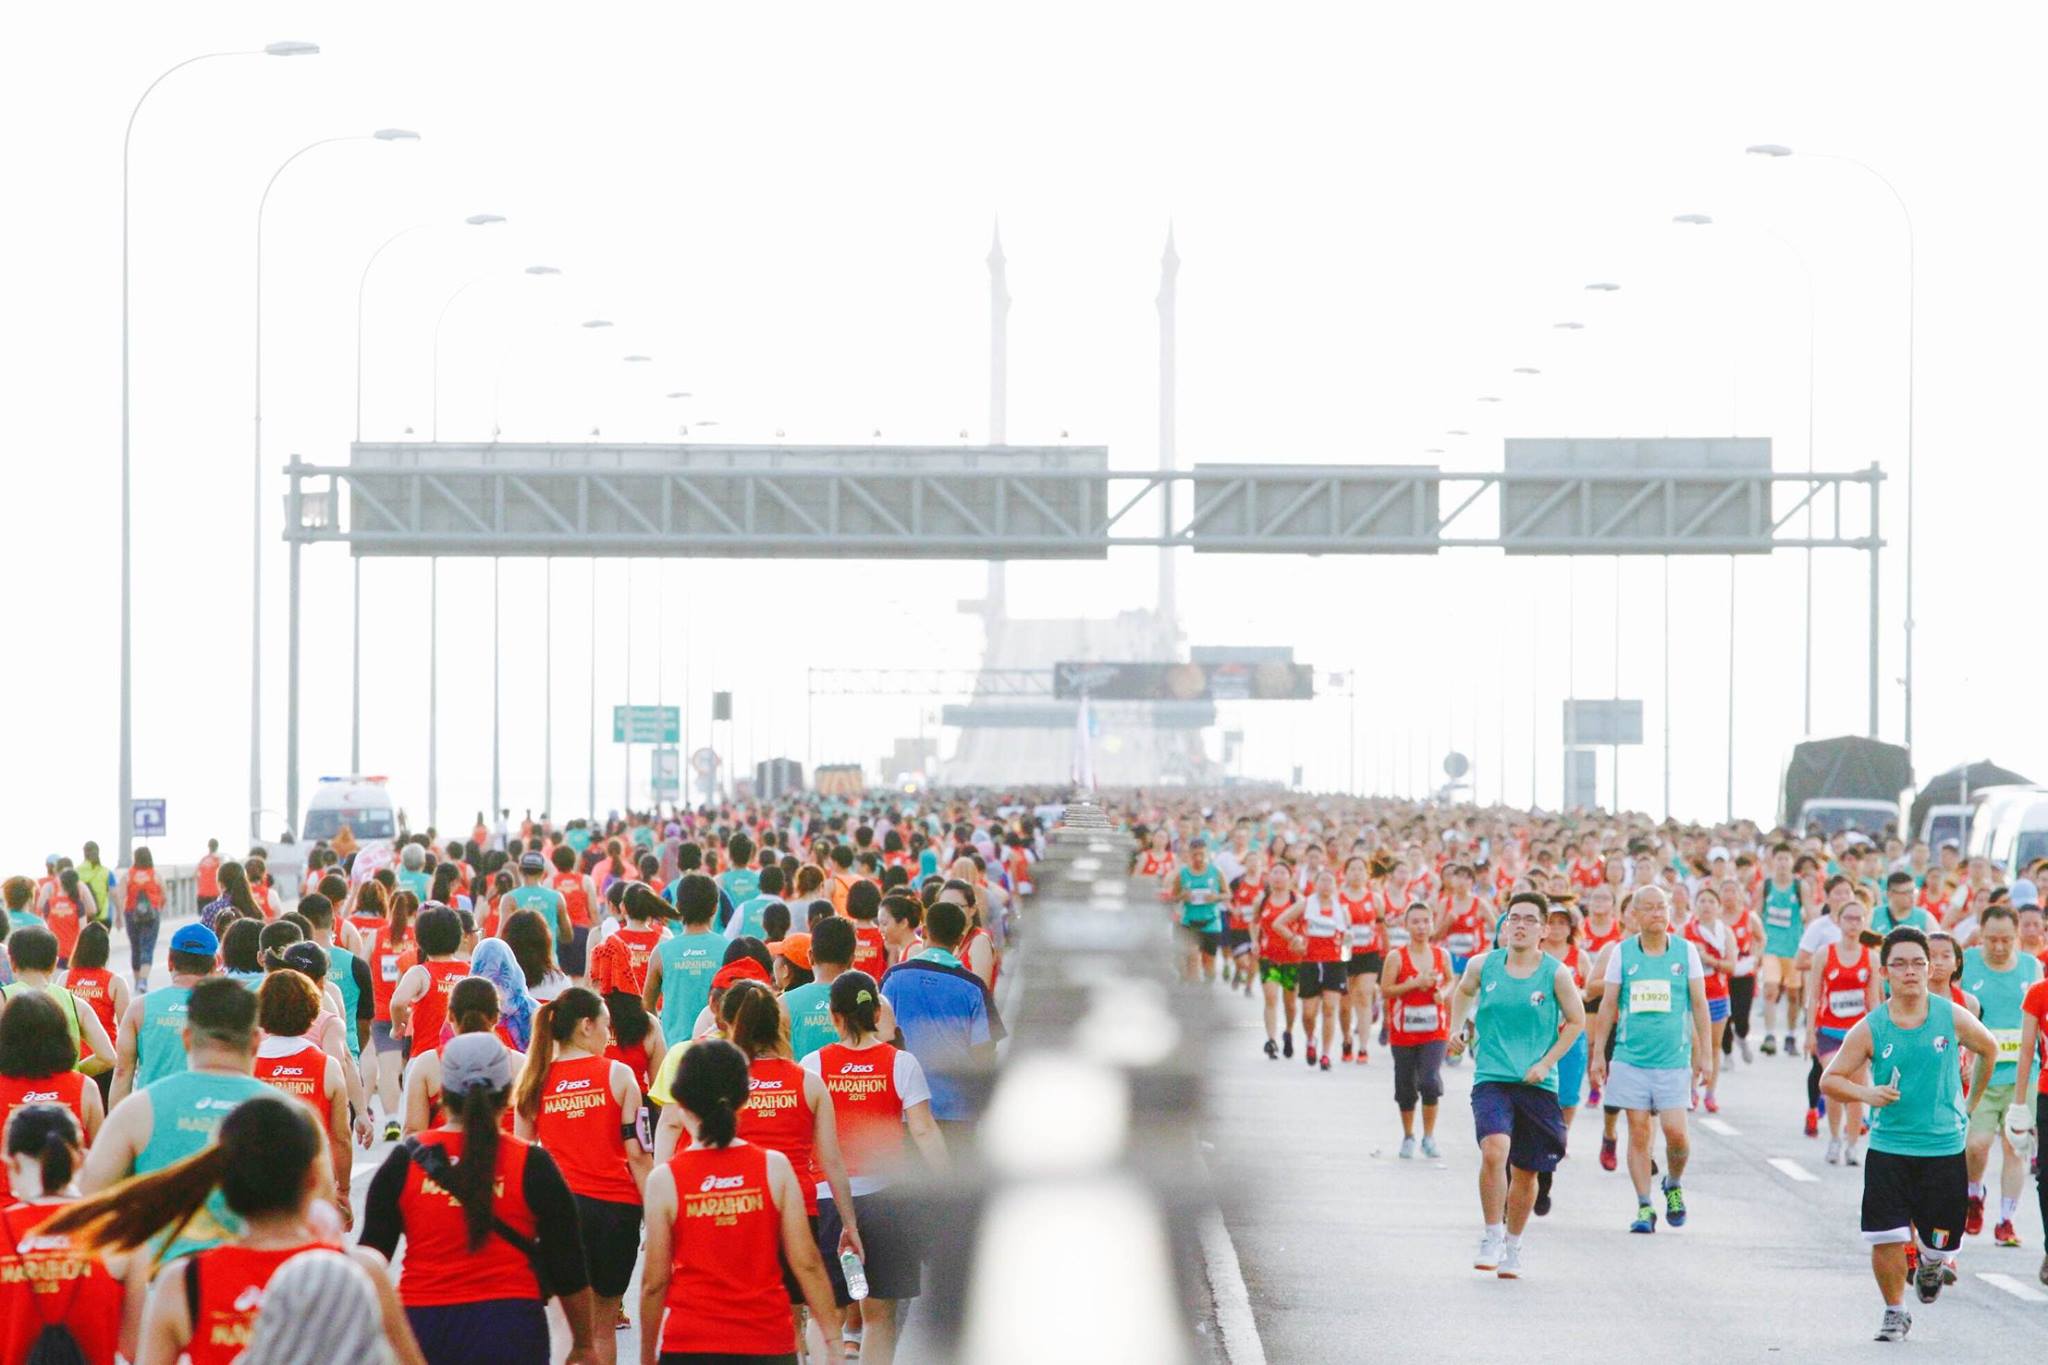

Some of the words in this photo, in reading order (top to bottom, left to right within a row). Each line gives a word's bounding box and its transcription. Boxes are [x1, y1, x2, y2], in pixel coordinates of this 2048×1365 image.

[827, 1079, 887, 1093] MARATHON
[544, 1093, 606, 1115] MARATHON
[745, 1094, 798, 1110] ARATHON
[848, 1093, 867, 1101] 2015
[566, 1108, 585, 1119] 2015
[757, 1109, 776, 1118] 2015
[685, 1193, 764, 1218] MARATHON
